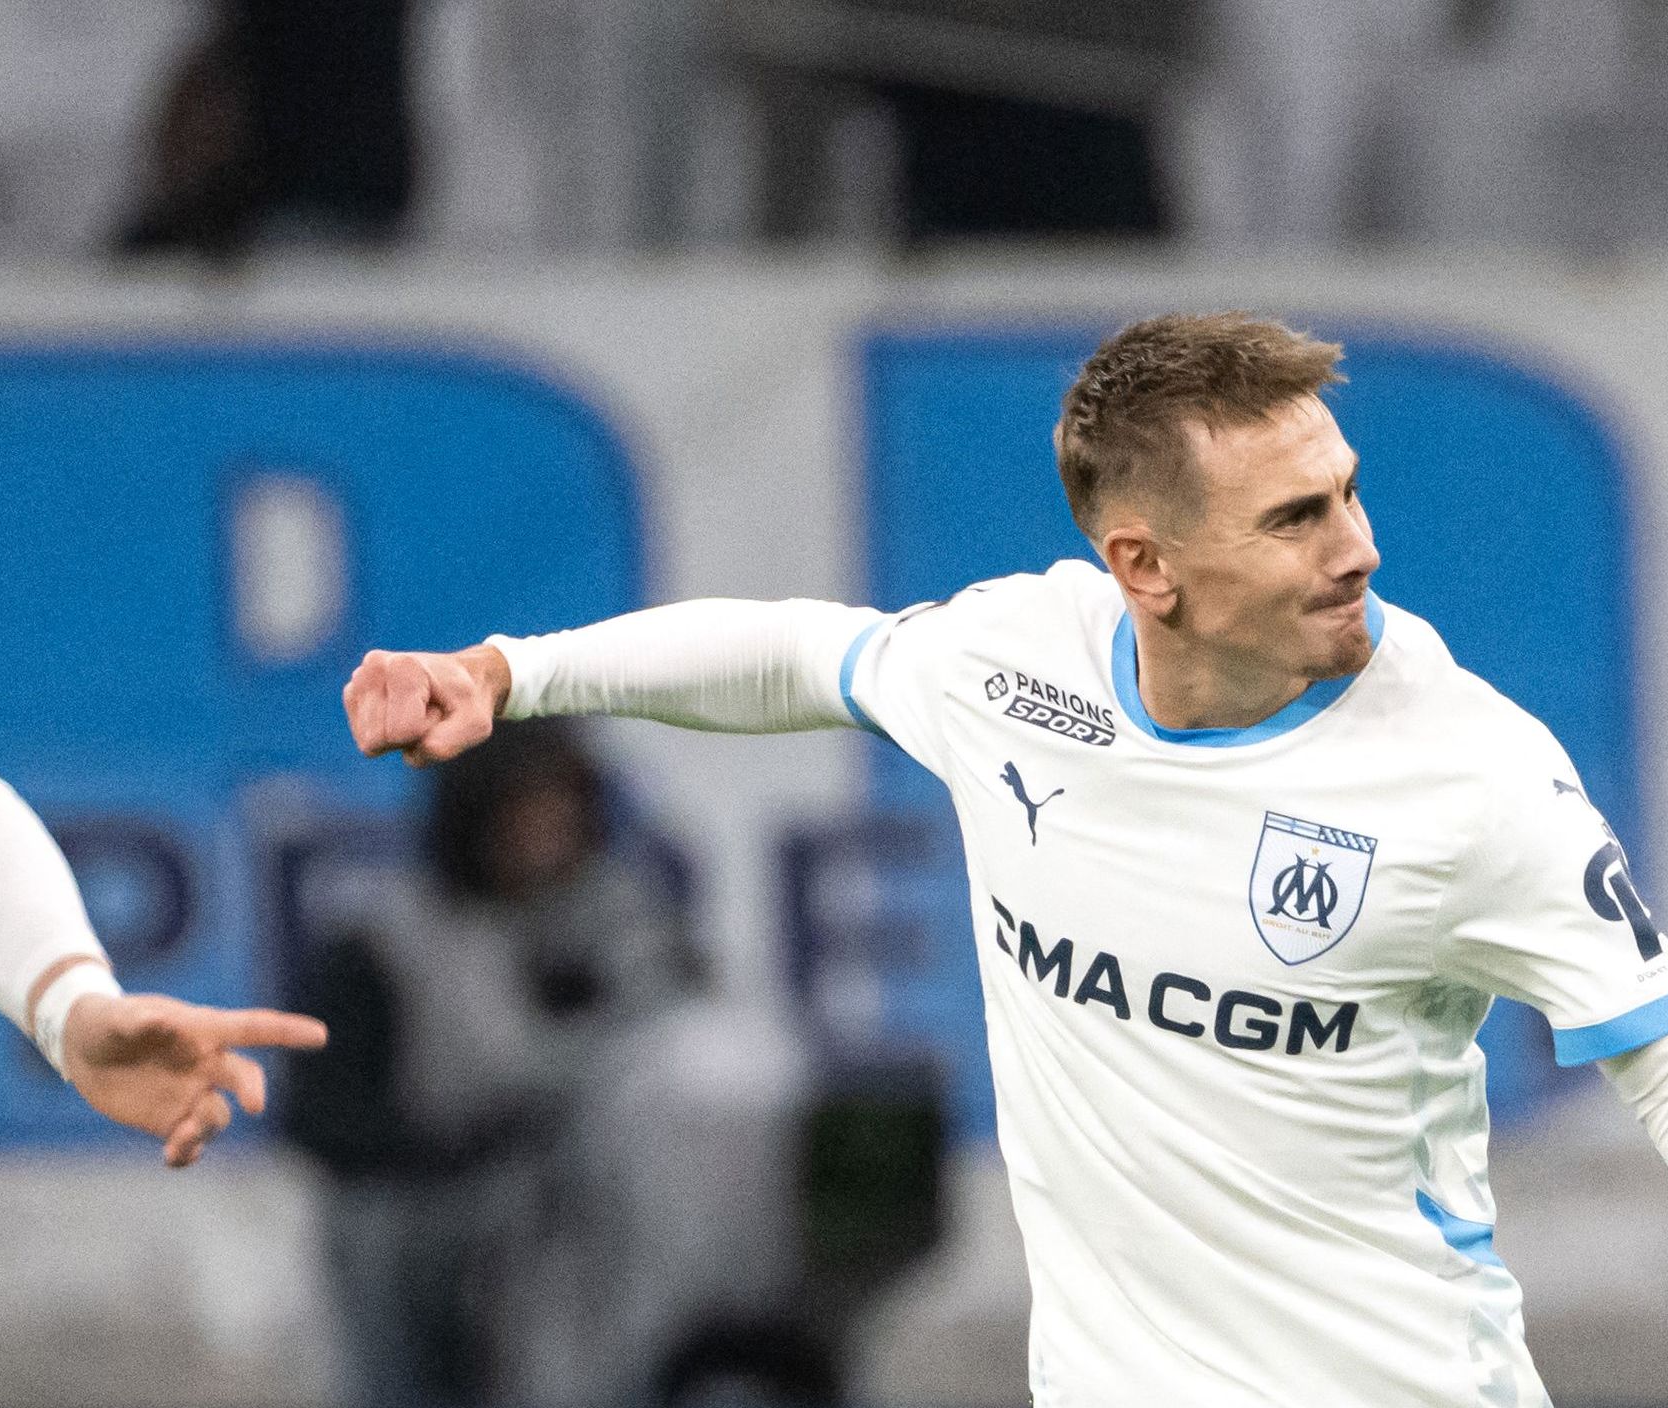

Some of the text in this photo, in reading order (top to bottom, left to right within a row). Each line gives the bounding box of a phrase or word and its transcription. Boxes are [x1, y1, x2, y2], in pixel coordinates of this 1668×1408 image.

[1007, 699, 1115, 746] SPORT
[1015, 671, 1115, 729] PARIONS
[991, 893, 1359, 1055] CMA CGM
